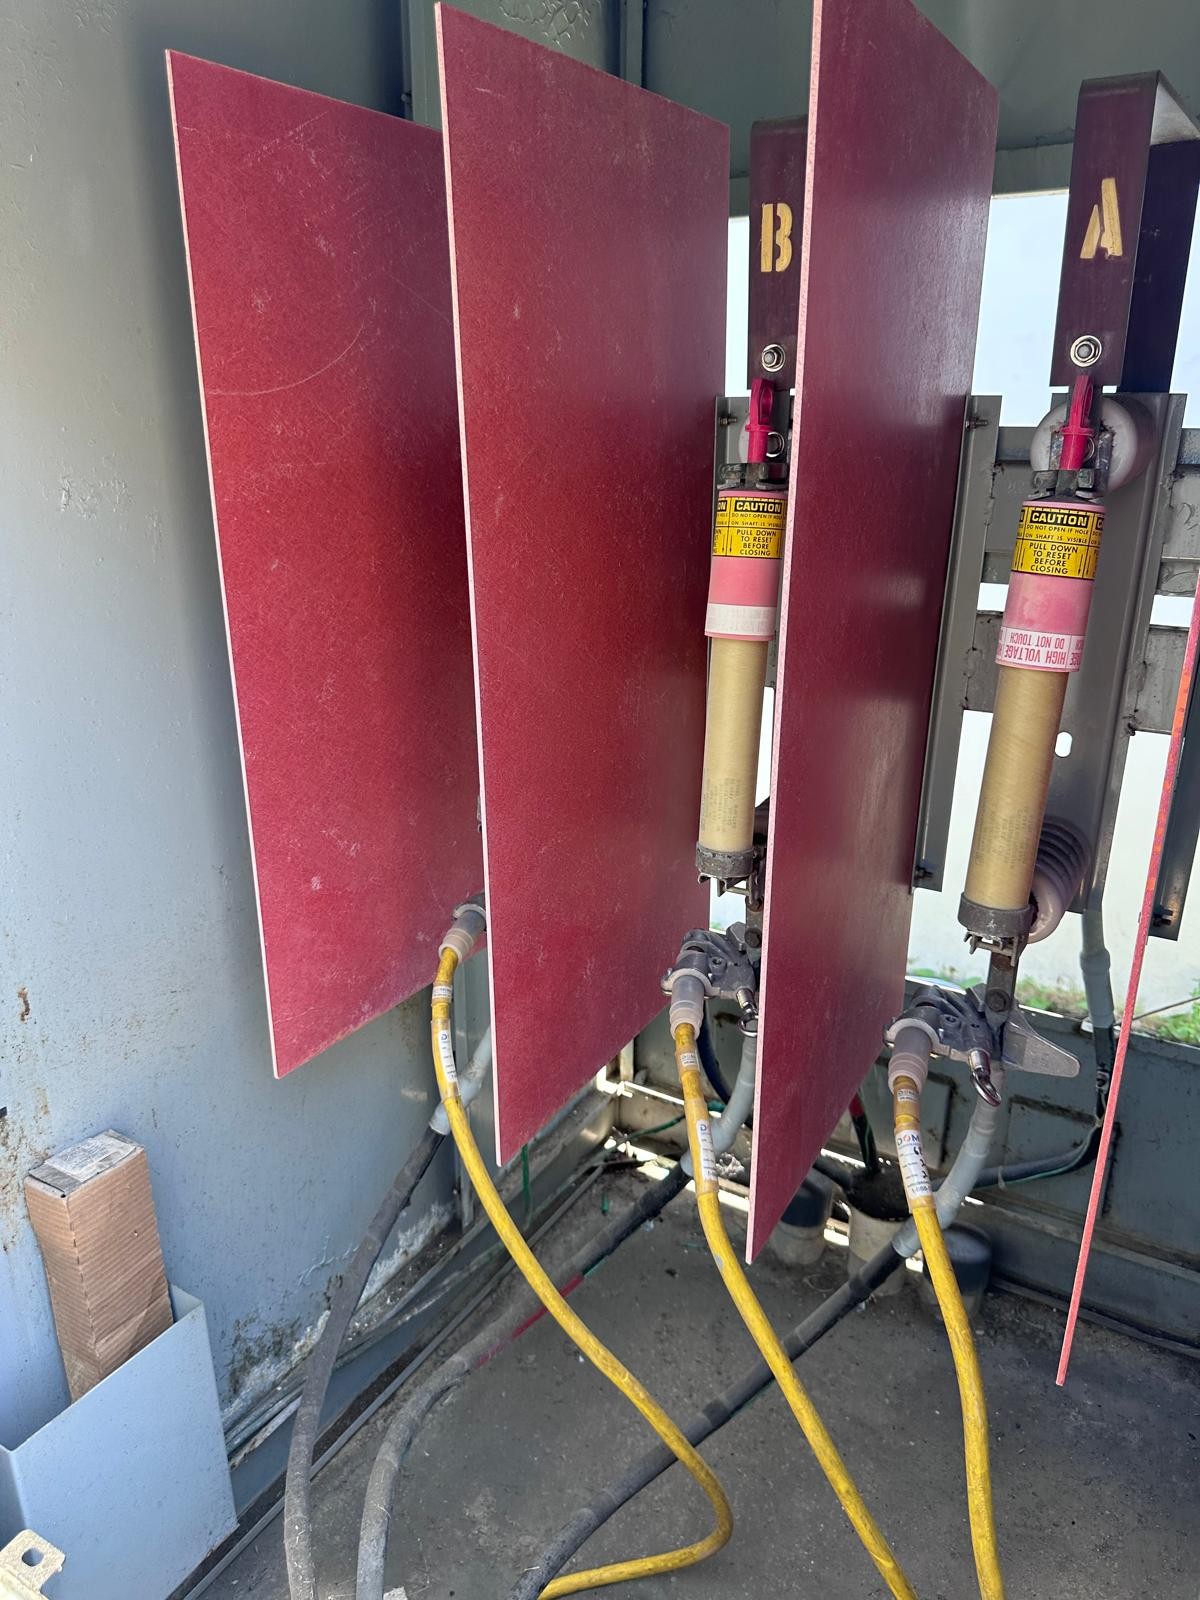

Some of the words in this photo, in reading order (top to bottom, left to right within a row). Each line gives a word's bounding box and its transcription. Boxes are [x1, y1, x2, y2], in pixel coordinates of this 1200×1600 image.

[1080, 177, 1123, 259] A
[760, 203, 793, 273] B
[736, 501, 781, 513] CAUTION
[1032, 512, 1088, 527] CAUTION
[1029, 542, 1047, 551] PULL
[1050, 544, 1079, 554] DOWN
[1034, 557, 1067, 567] BEFORE
[1046, 551, 1071, 560] RESET
[1030, 564, 1068, 575] CLOSING
[1010, 632, 1032, 646] TOUCH
[1035, 634, 1053, 649] NOT
[1054, 637, 1065, 650] DO
[1004, 645, 1041, 663] VOLTAGE
[1045, 651, 1067, 666] HIGH
